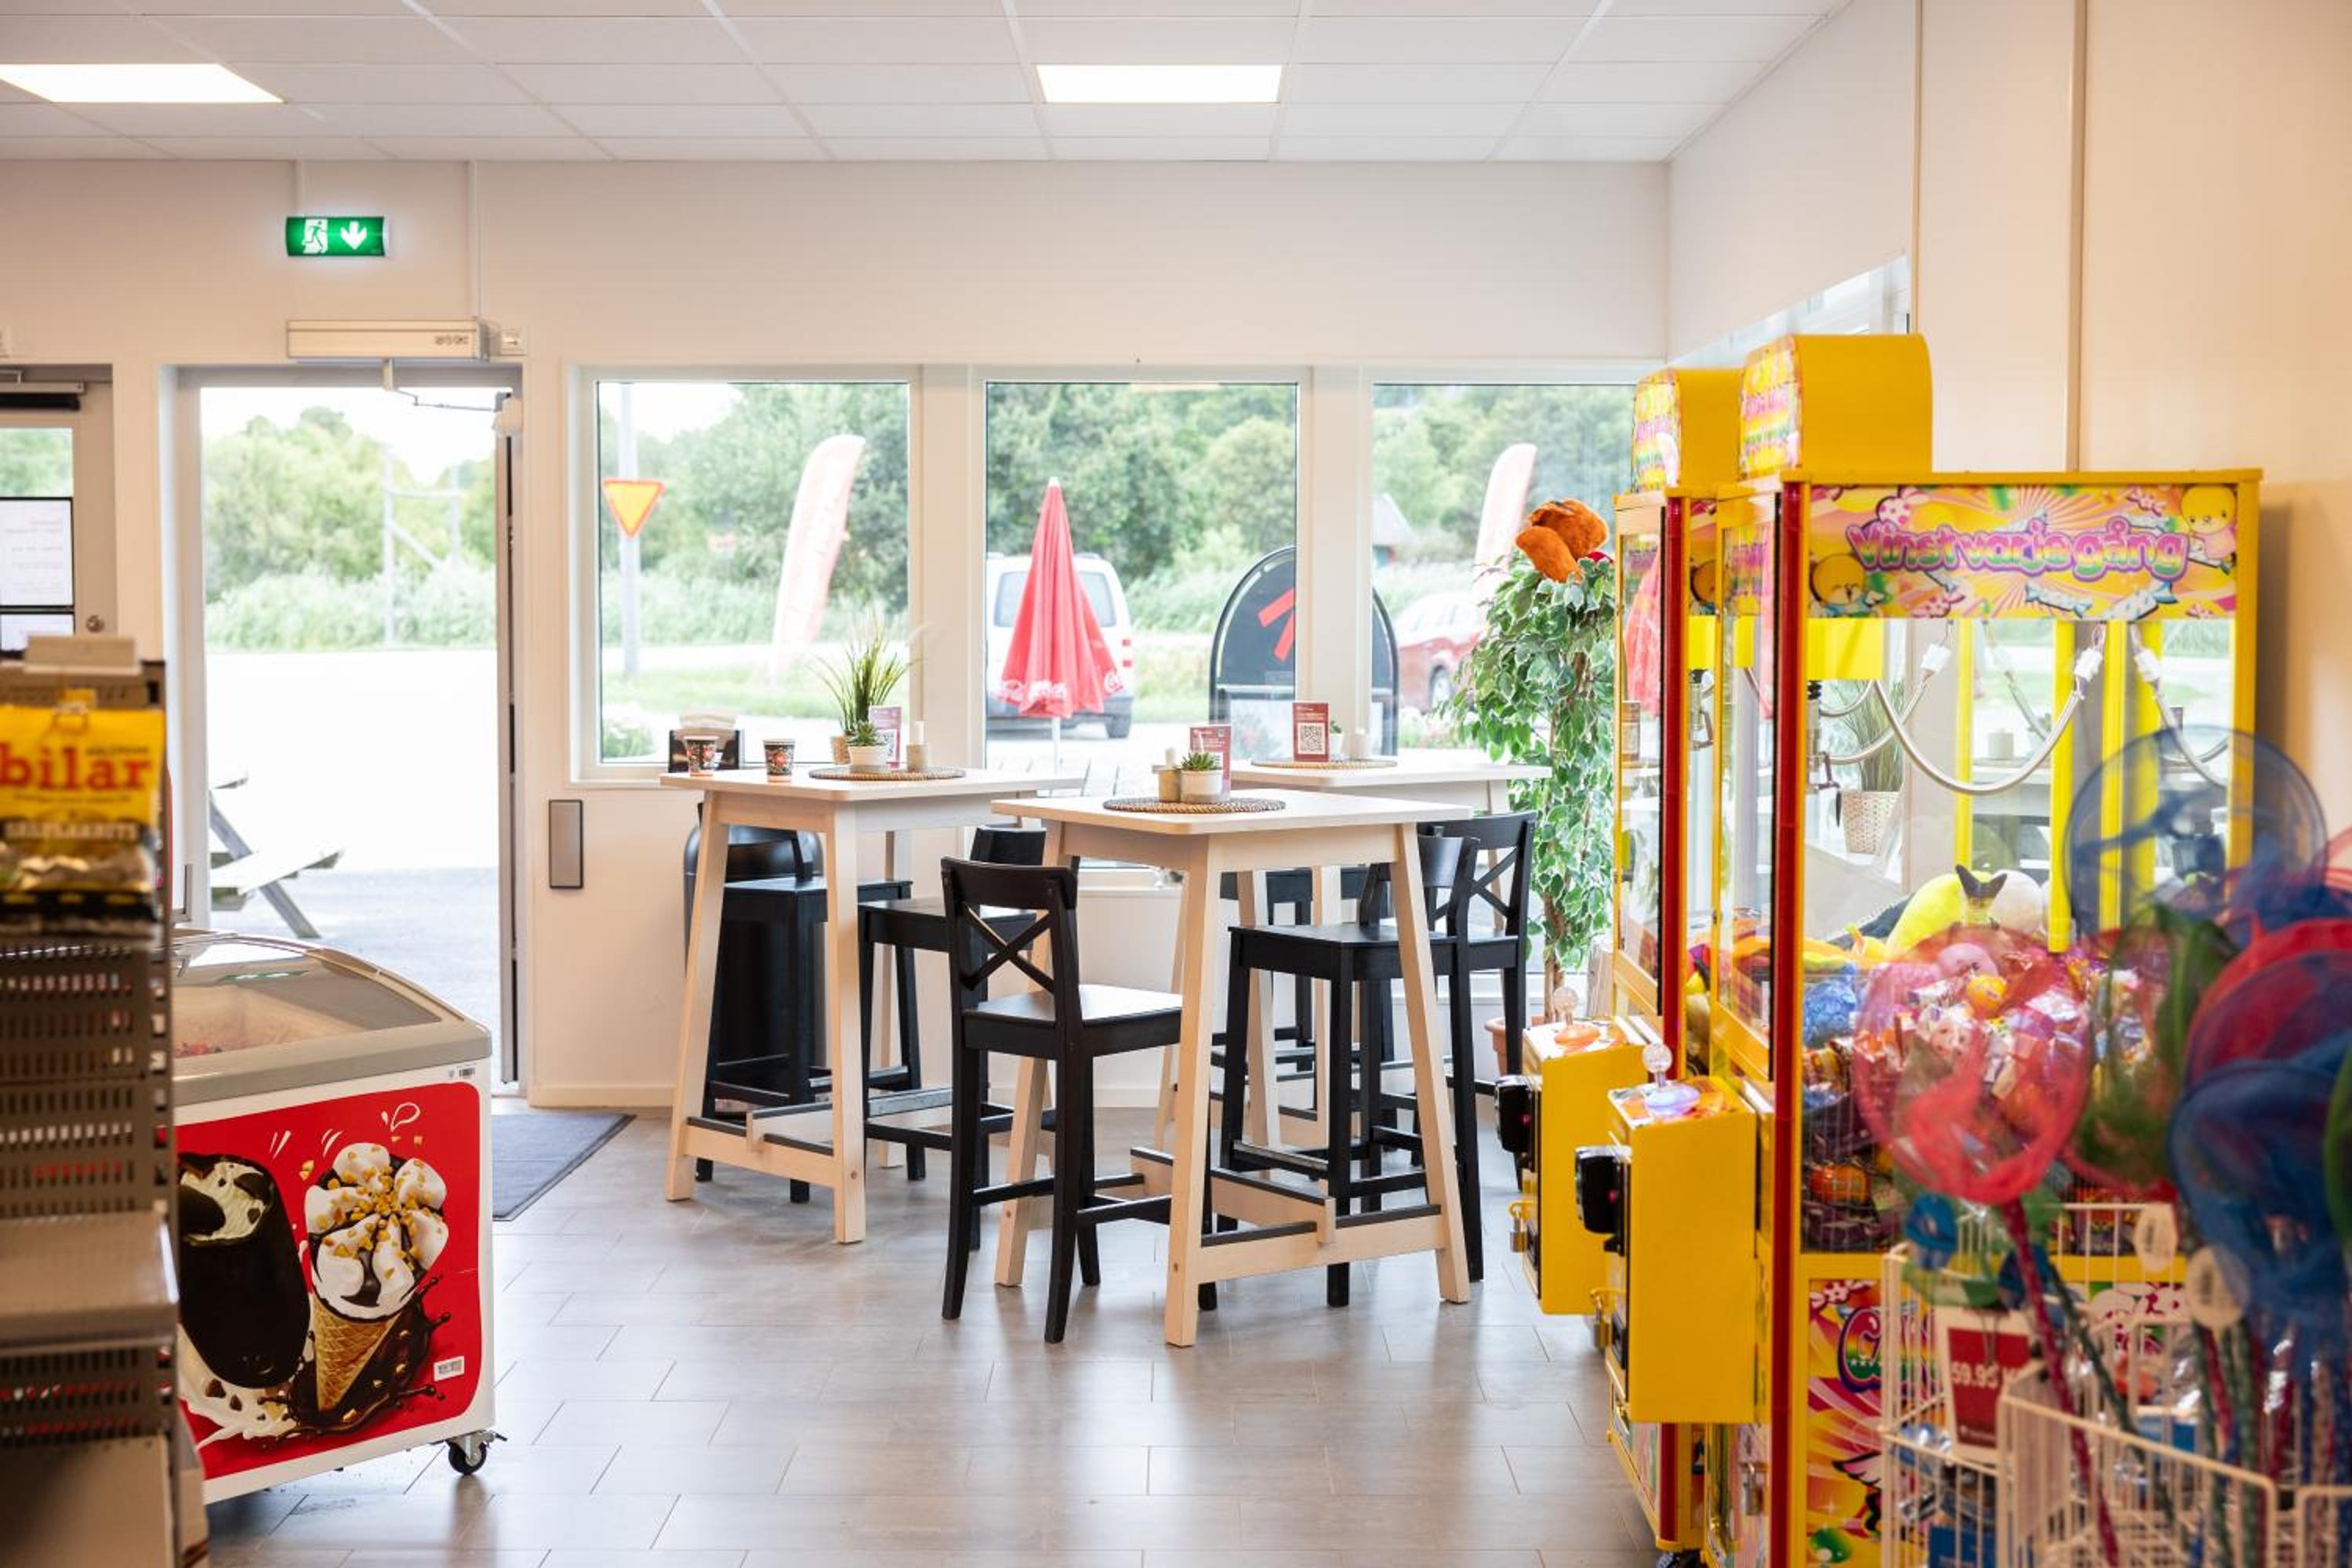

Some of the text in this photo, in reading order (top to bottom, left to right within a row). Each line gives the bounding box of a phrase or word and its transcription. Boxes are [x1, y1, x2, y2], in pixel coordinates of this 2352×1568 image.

[1846, 517, 2187, 583] Vinst varje gång
[0, 742, 151, 789] bilar
